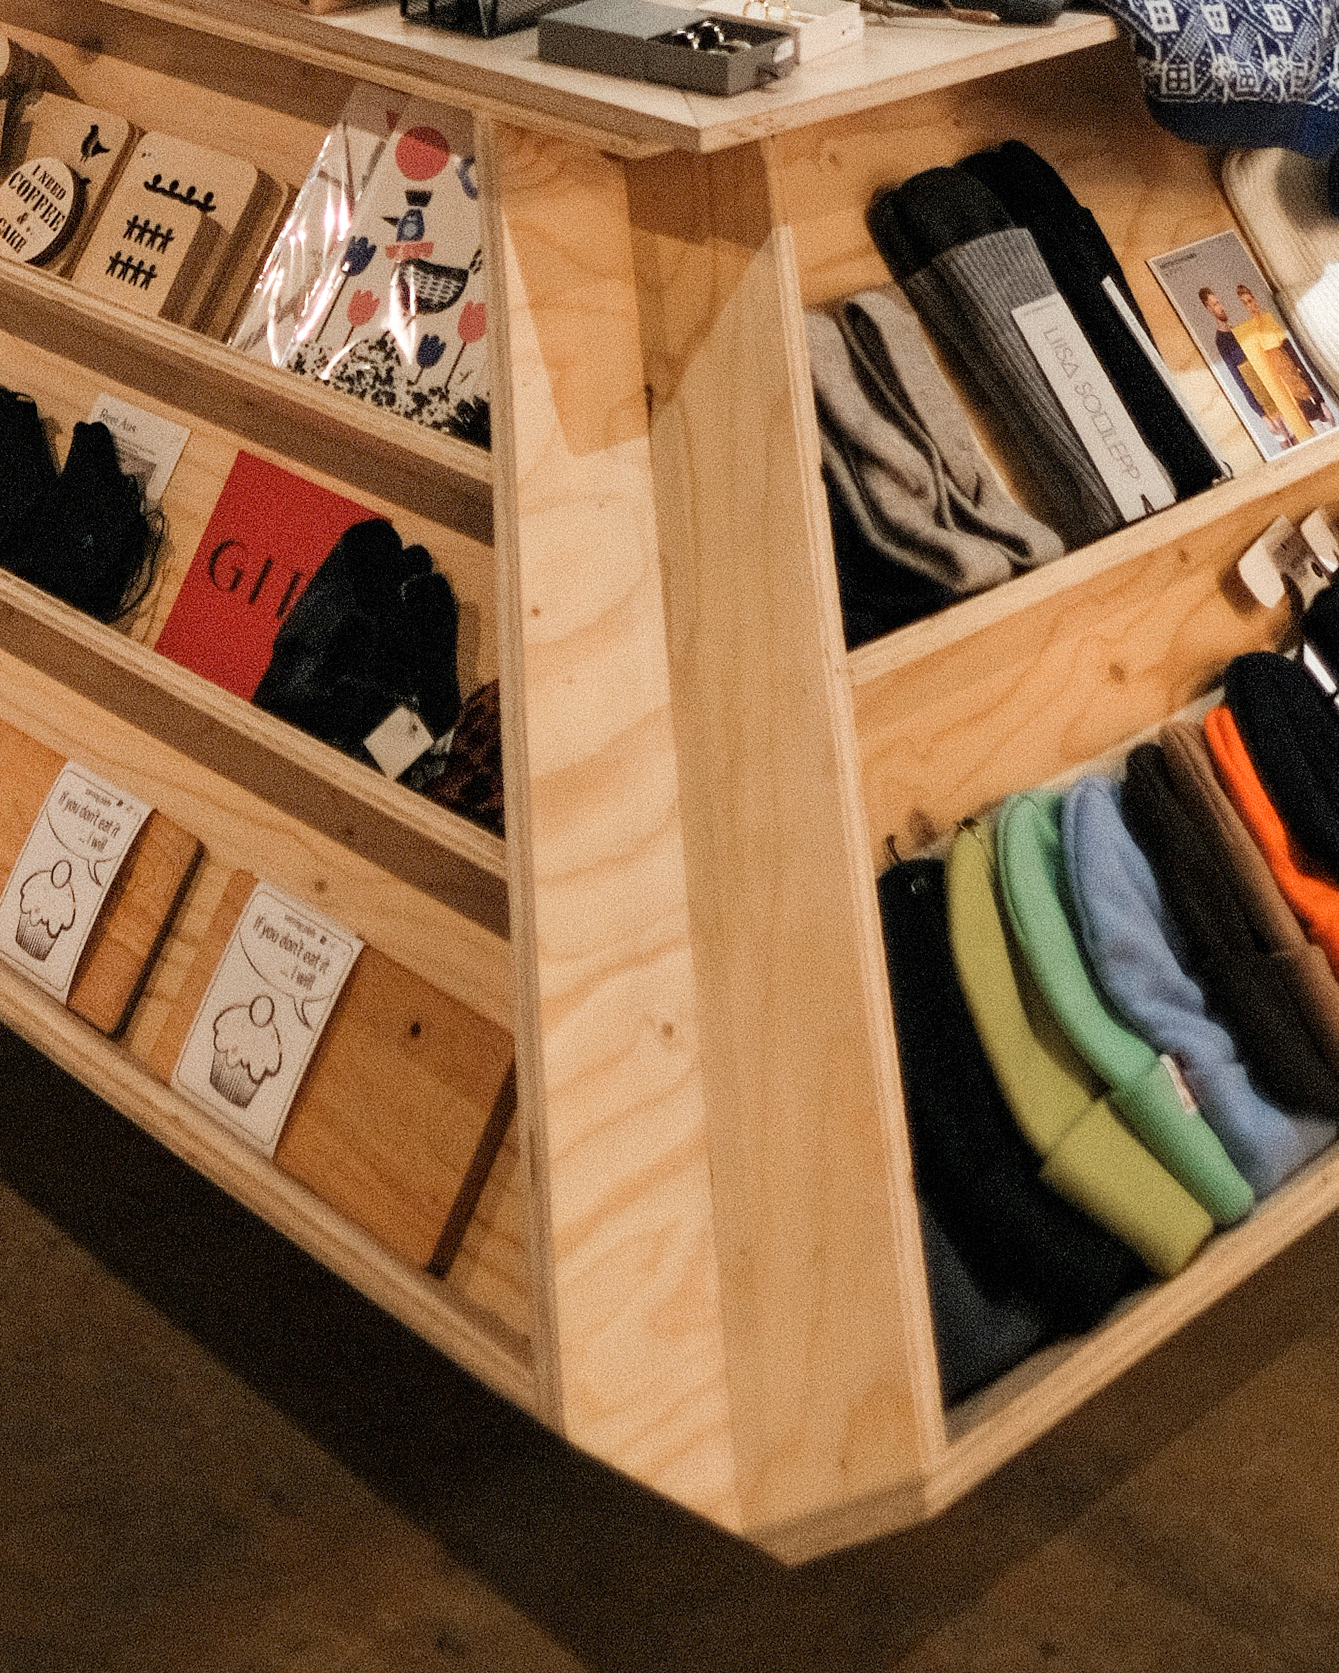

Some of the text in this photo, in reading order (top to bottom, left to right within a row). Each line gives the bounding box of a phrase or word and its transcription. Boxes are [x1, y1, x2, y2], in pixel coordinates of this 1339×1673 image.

[8, 171, 66, 232] COFFEE
[32, 165, 66, 200] I NEED
[16, 213, 29, 224] &
[1044, 327, 1079, 379] LIISA
[63, 799, 82, 815] you
[79, 805, 100, 827] don't
[98, 819, 114, 834] eat
[259, 925, 280, 943] you
[279, 933, 304, 958] don't
[303, 951, 321, 970] eat
